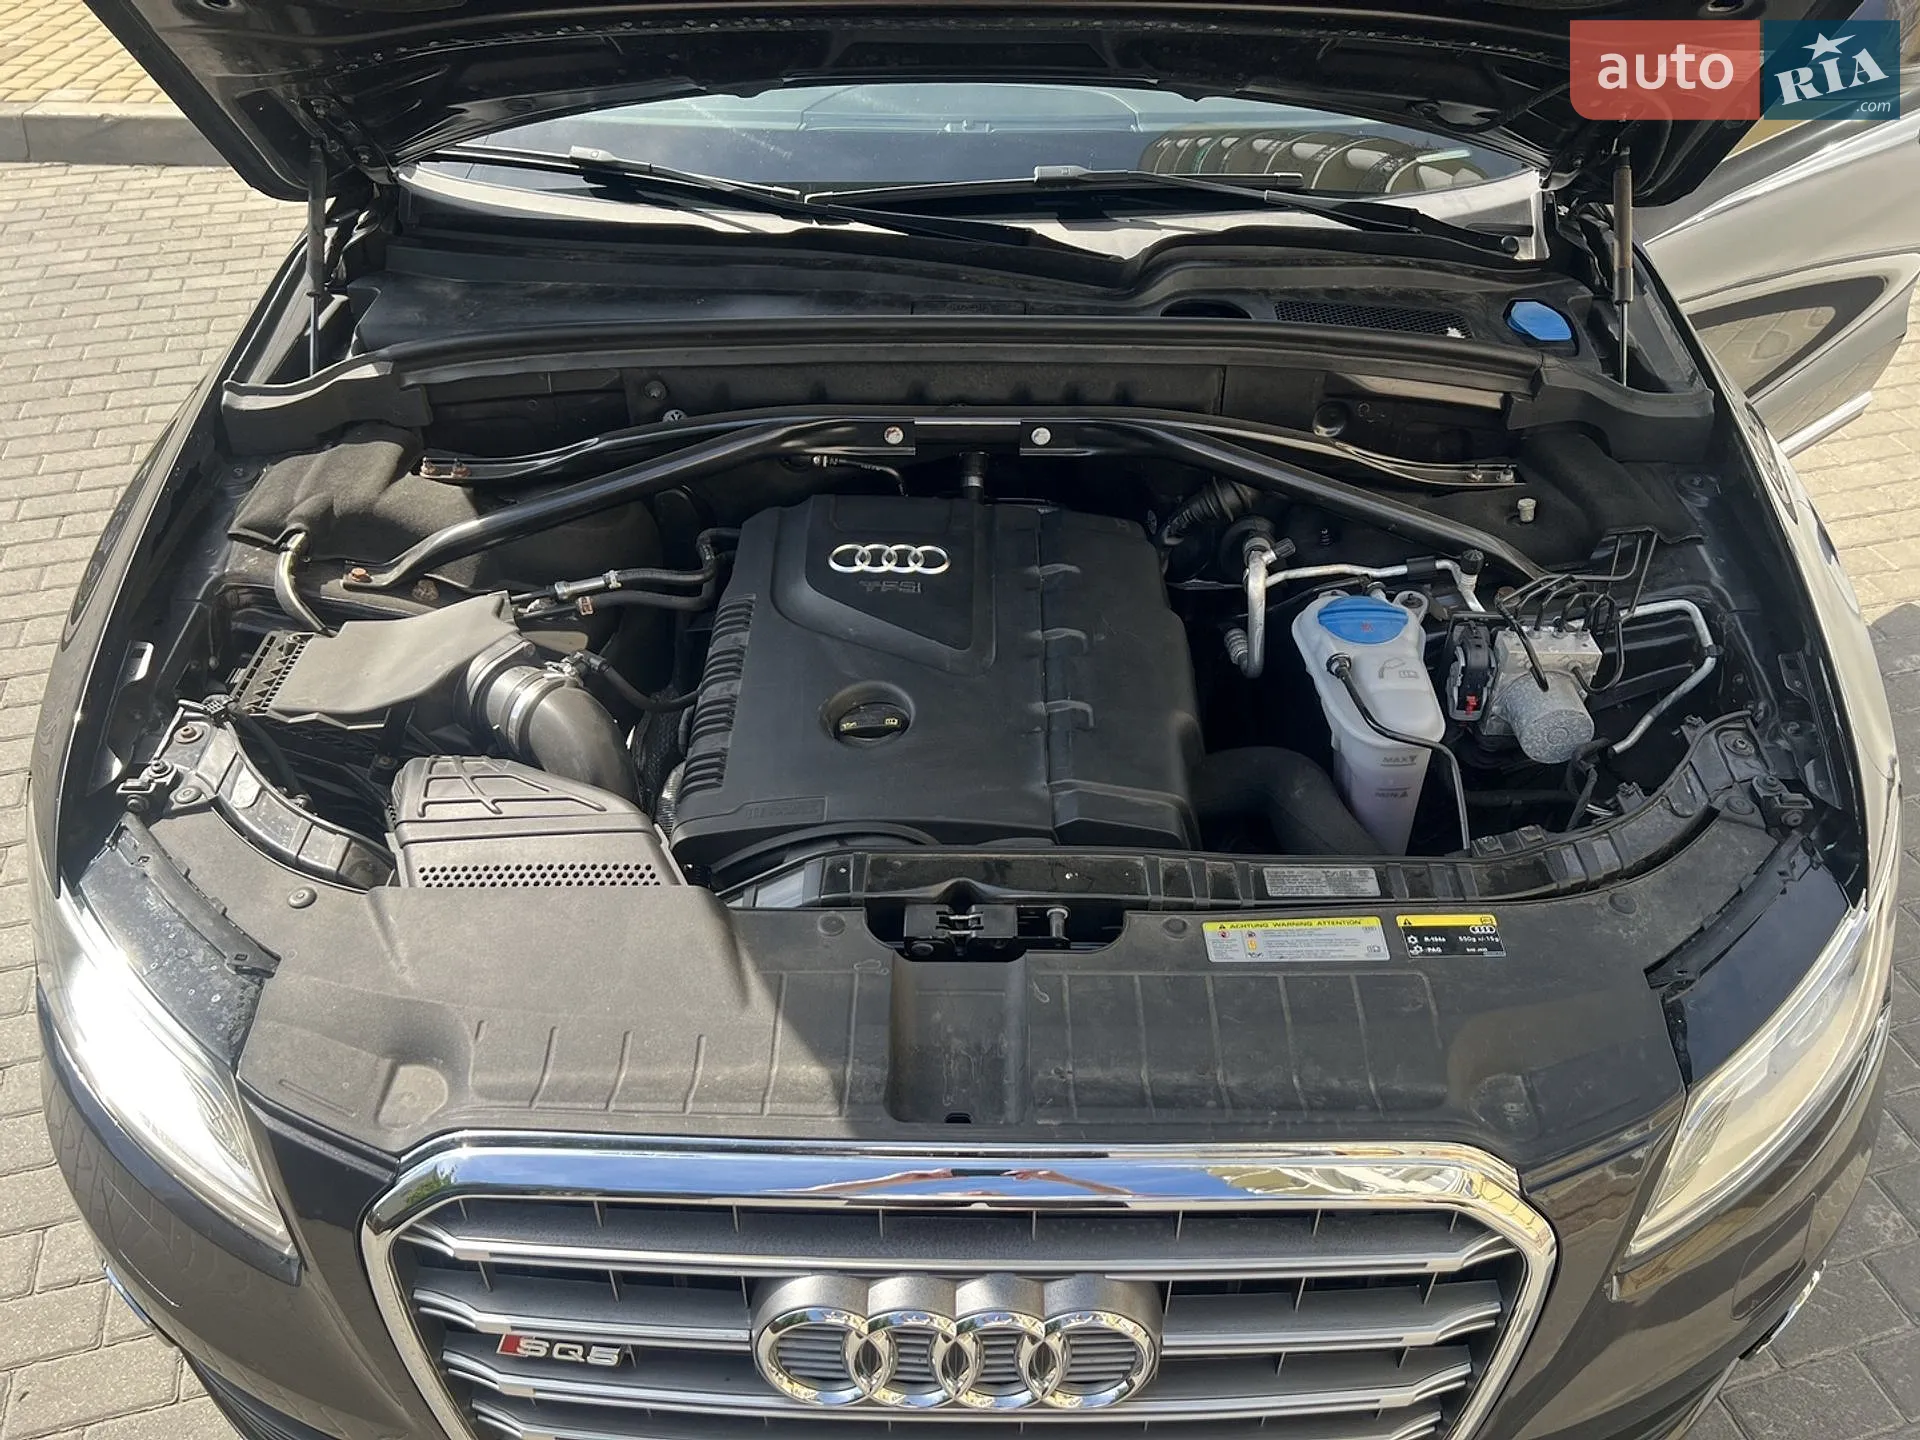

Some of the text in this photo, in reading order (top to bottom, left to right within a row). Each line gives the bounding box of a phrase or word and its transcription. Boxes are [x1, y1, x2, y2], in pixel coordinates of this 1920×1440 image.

[1229, 922, 1269, 930] ACHTUNG
[1317, 919, 1362, 927] ATTENTION
[516, 1337, 619, 1366] SQ5
